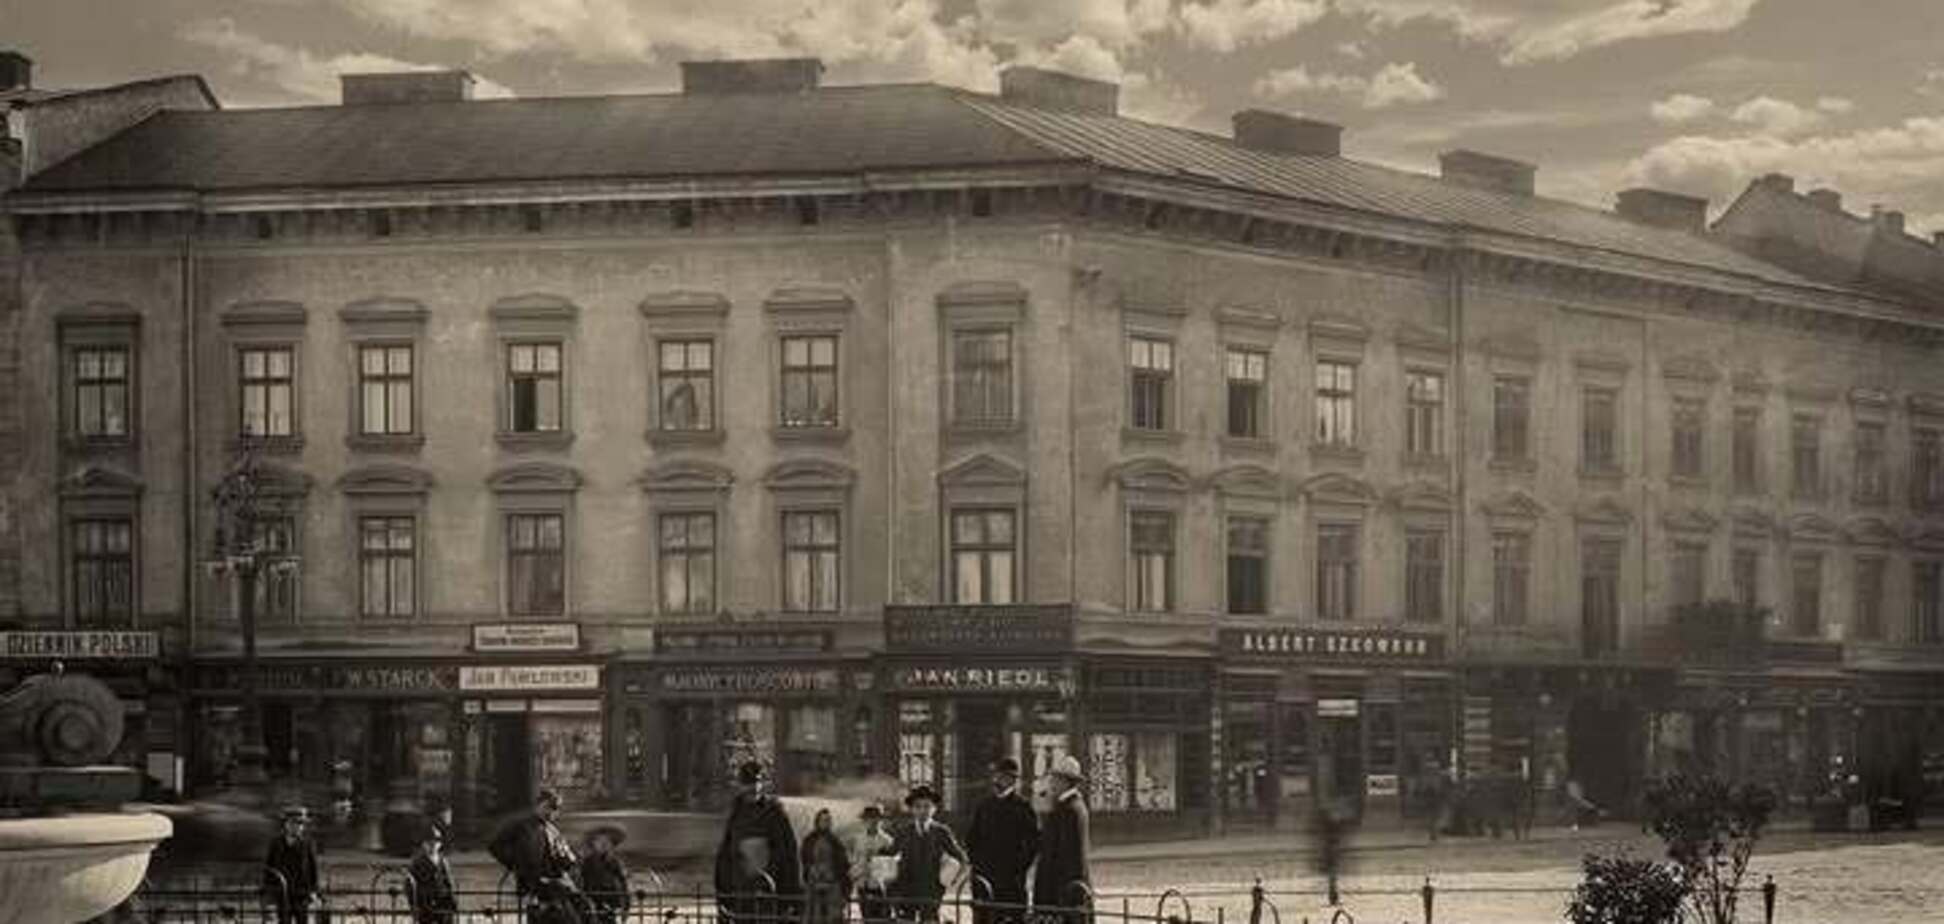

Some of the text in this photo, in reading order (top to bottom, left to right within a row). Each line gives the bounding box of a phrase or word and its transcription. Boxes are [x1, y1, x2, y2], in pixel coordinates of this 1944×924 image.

[88, 635, 151, 654] POLSKI
[1242, 633, 1315, 652] ALBERT
[906, 667, 1048, 687] JAN RIEDL
